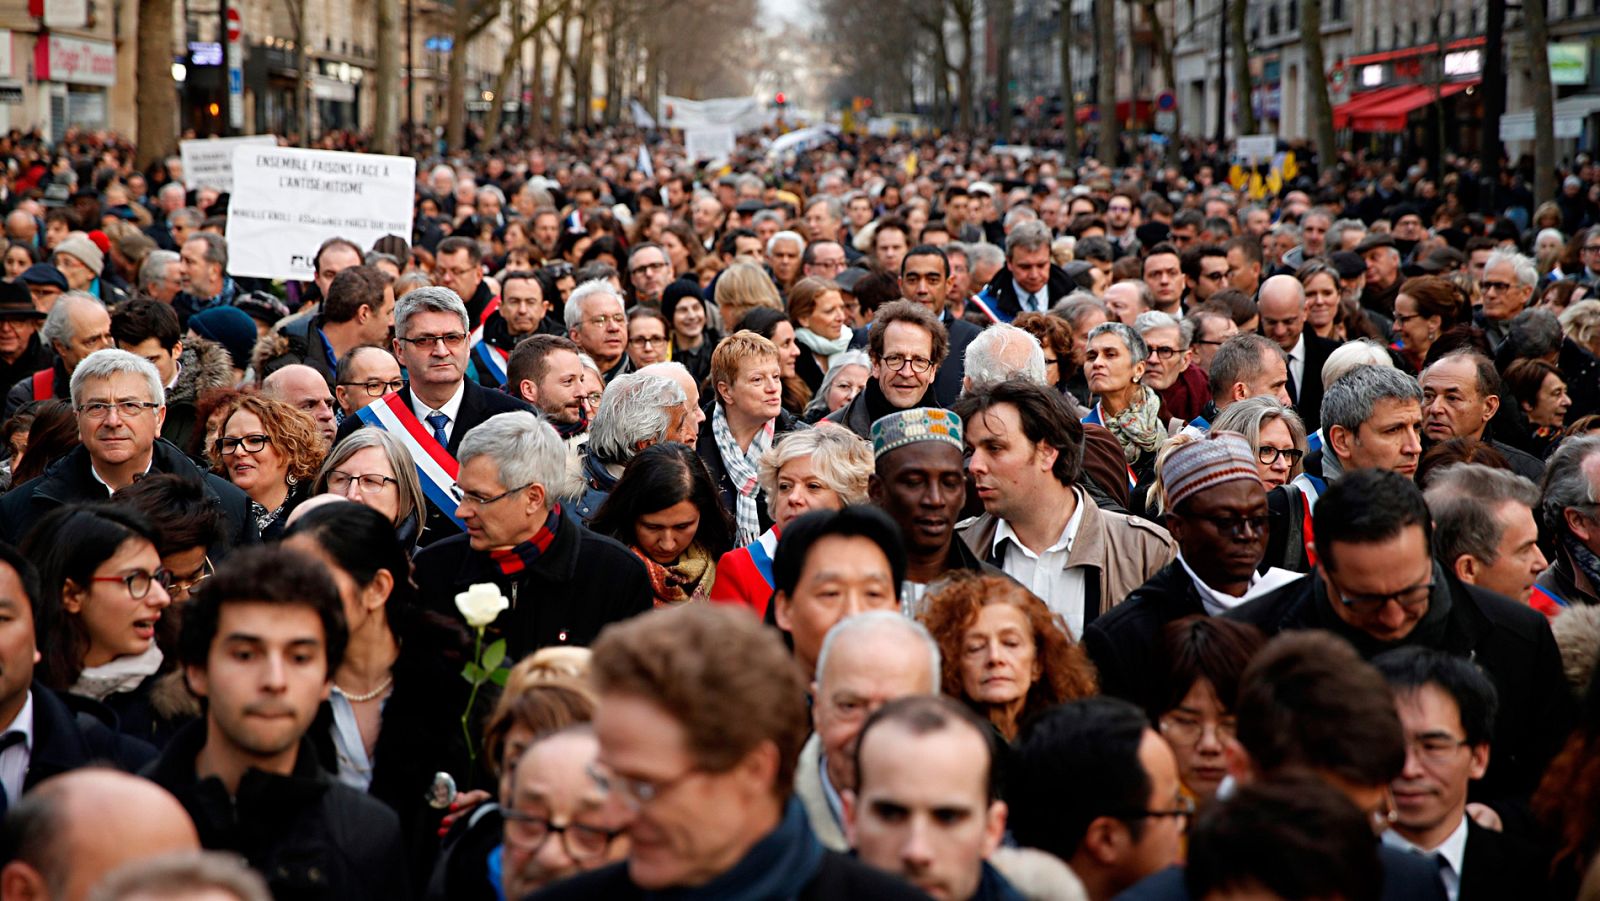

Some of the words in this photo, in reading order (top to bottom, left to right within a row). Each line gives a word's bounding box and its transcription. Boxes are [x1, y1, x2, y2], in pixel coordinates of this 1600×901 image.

[256, 155, 307, 171] ENSEMBLE
[312, 158, 353, 174] FAISONS
[356, 163, 379, 176] FACE
